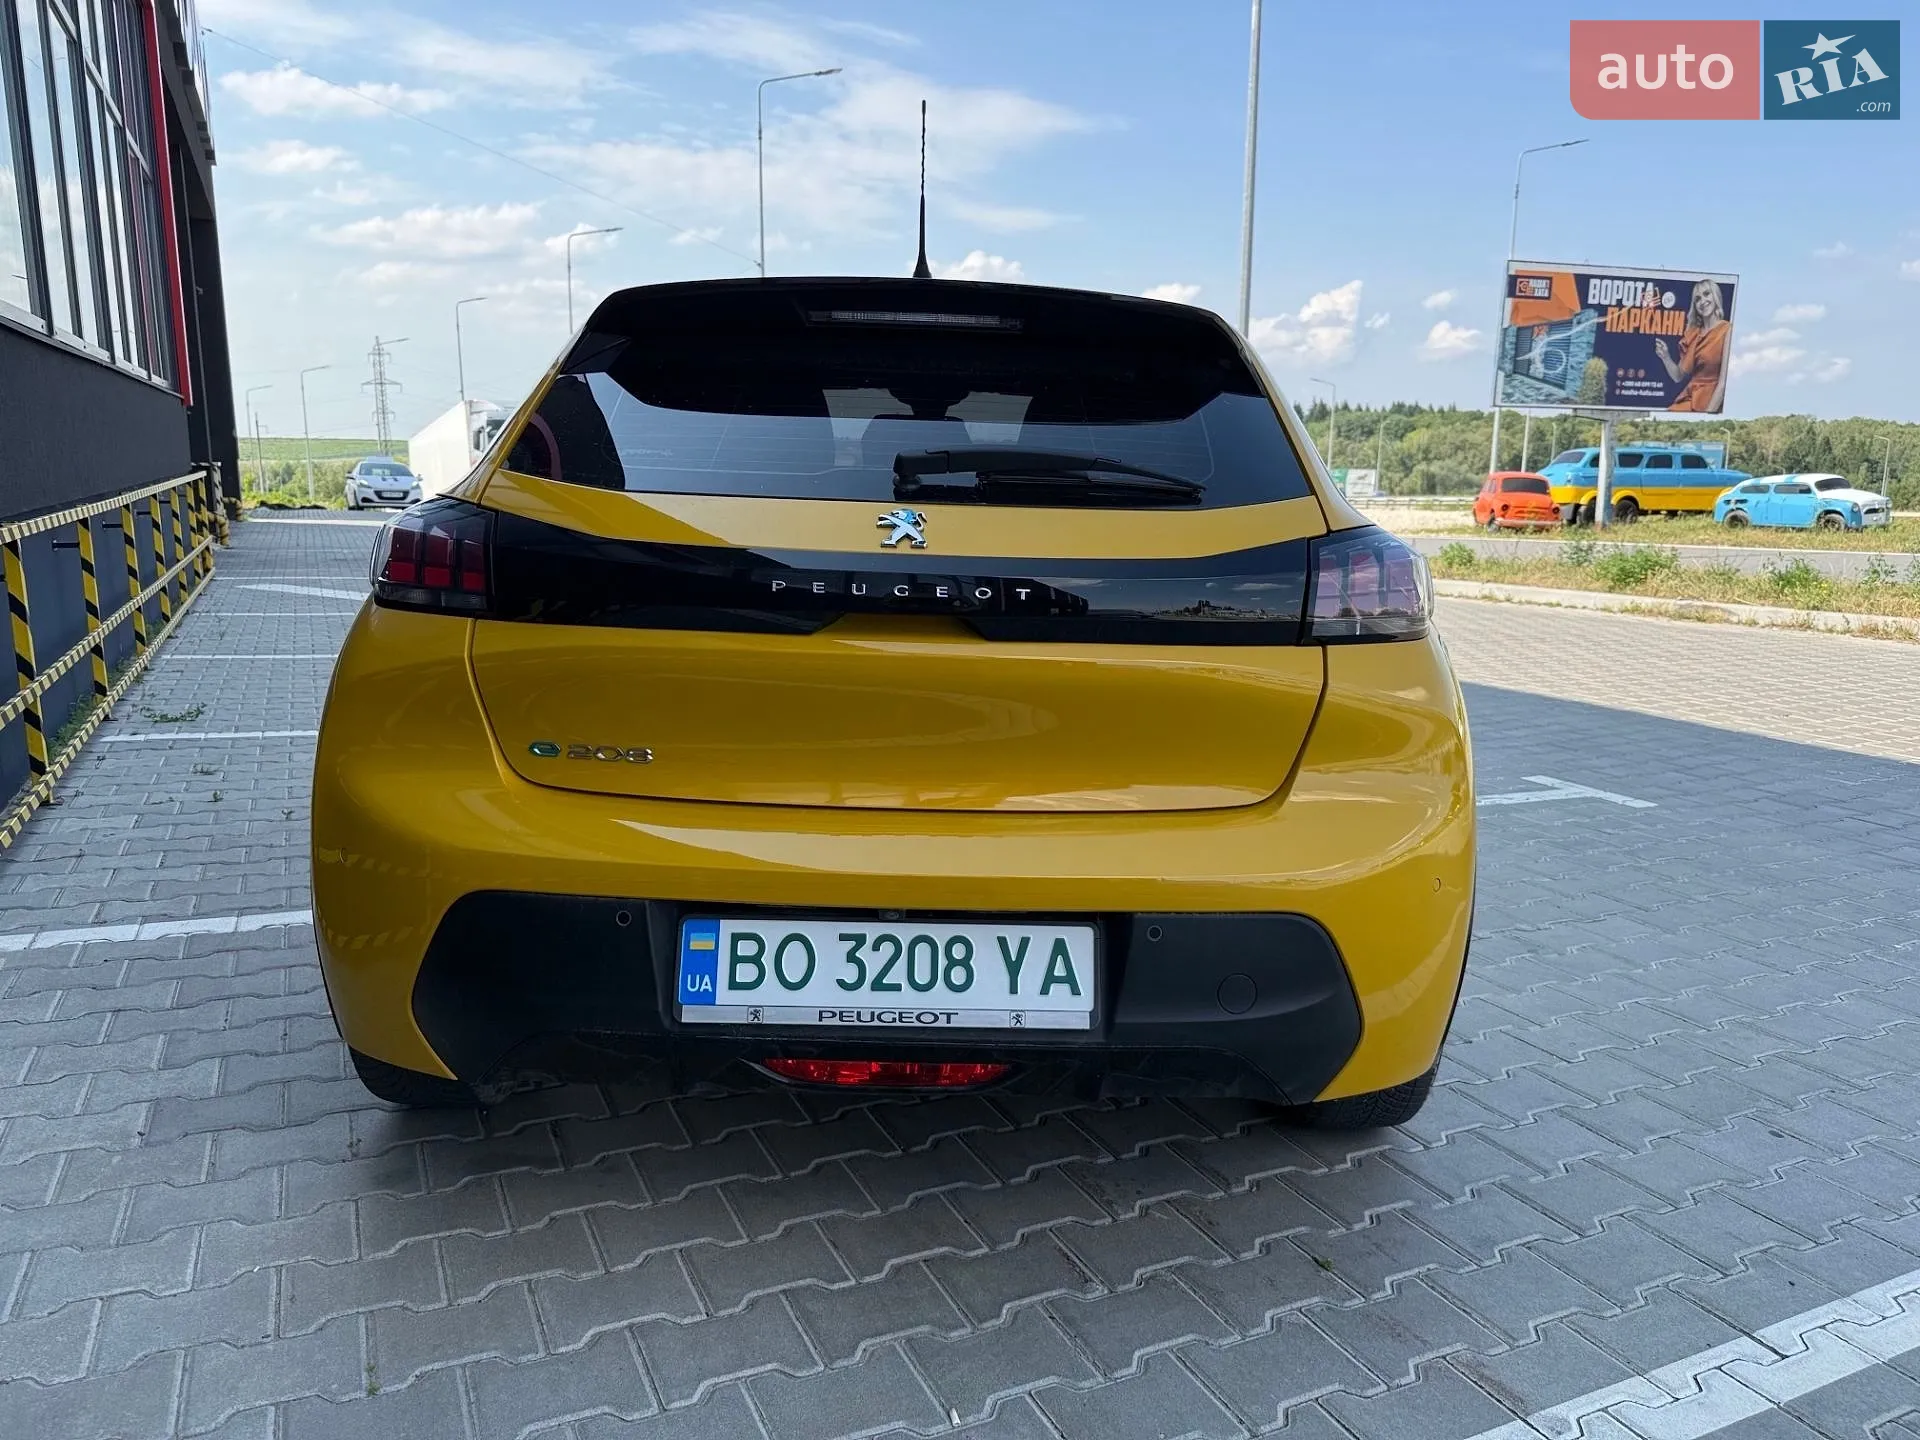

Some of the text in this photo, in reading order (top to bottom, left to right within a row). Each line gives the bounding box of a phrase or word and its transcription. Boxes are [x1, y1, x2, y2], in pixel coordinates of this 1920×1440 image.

[1587, 278, 1655, 308] ВОРОТА
[1605, 306, 1686, 336] ПАРКАНИ
[771, 580, 1032, 601] PEUGEOT
[728, 932, 1082, 996] BO 3208 YA
[687, 973, 713, 993] UA
[818, 1010, 959, 1025] PEUGEOT
